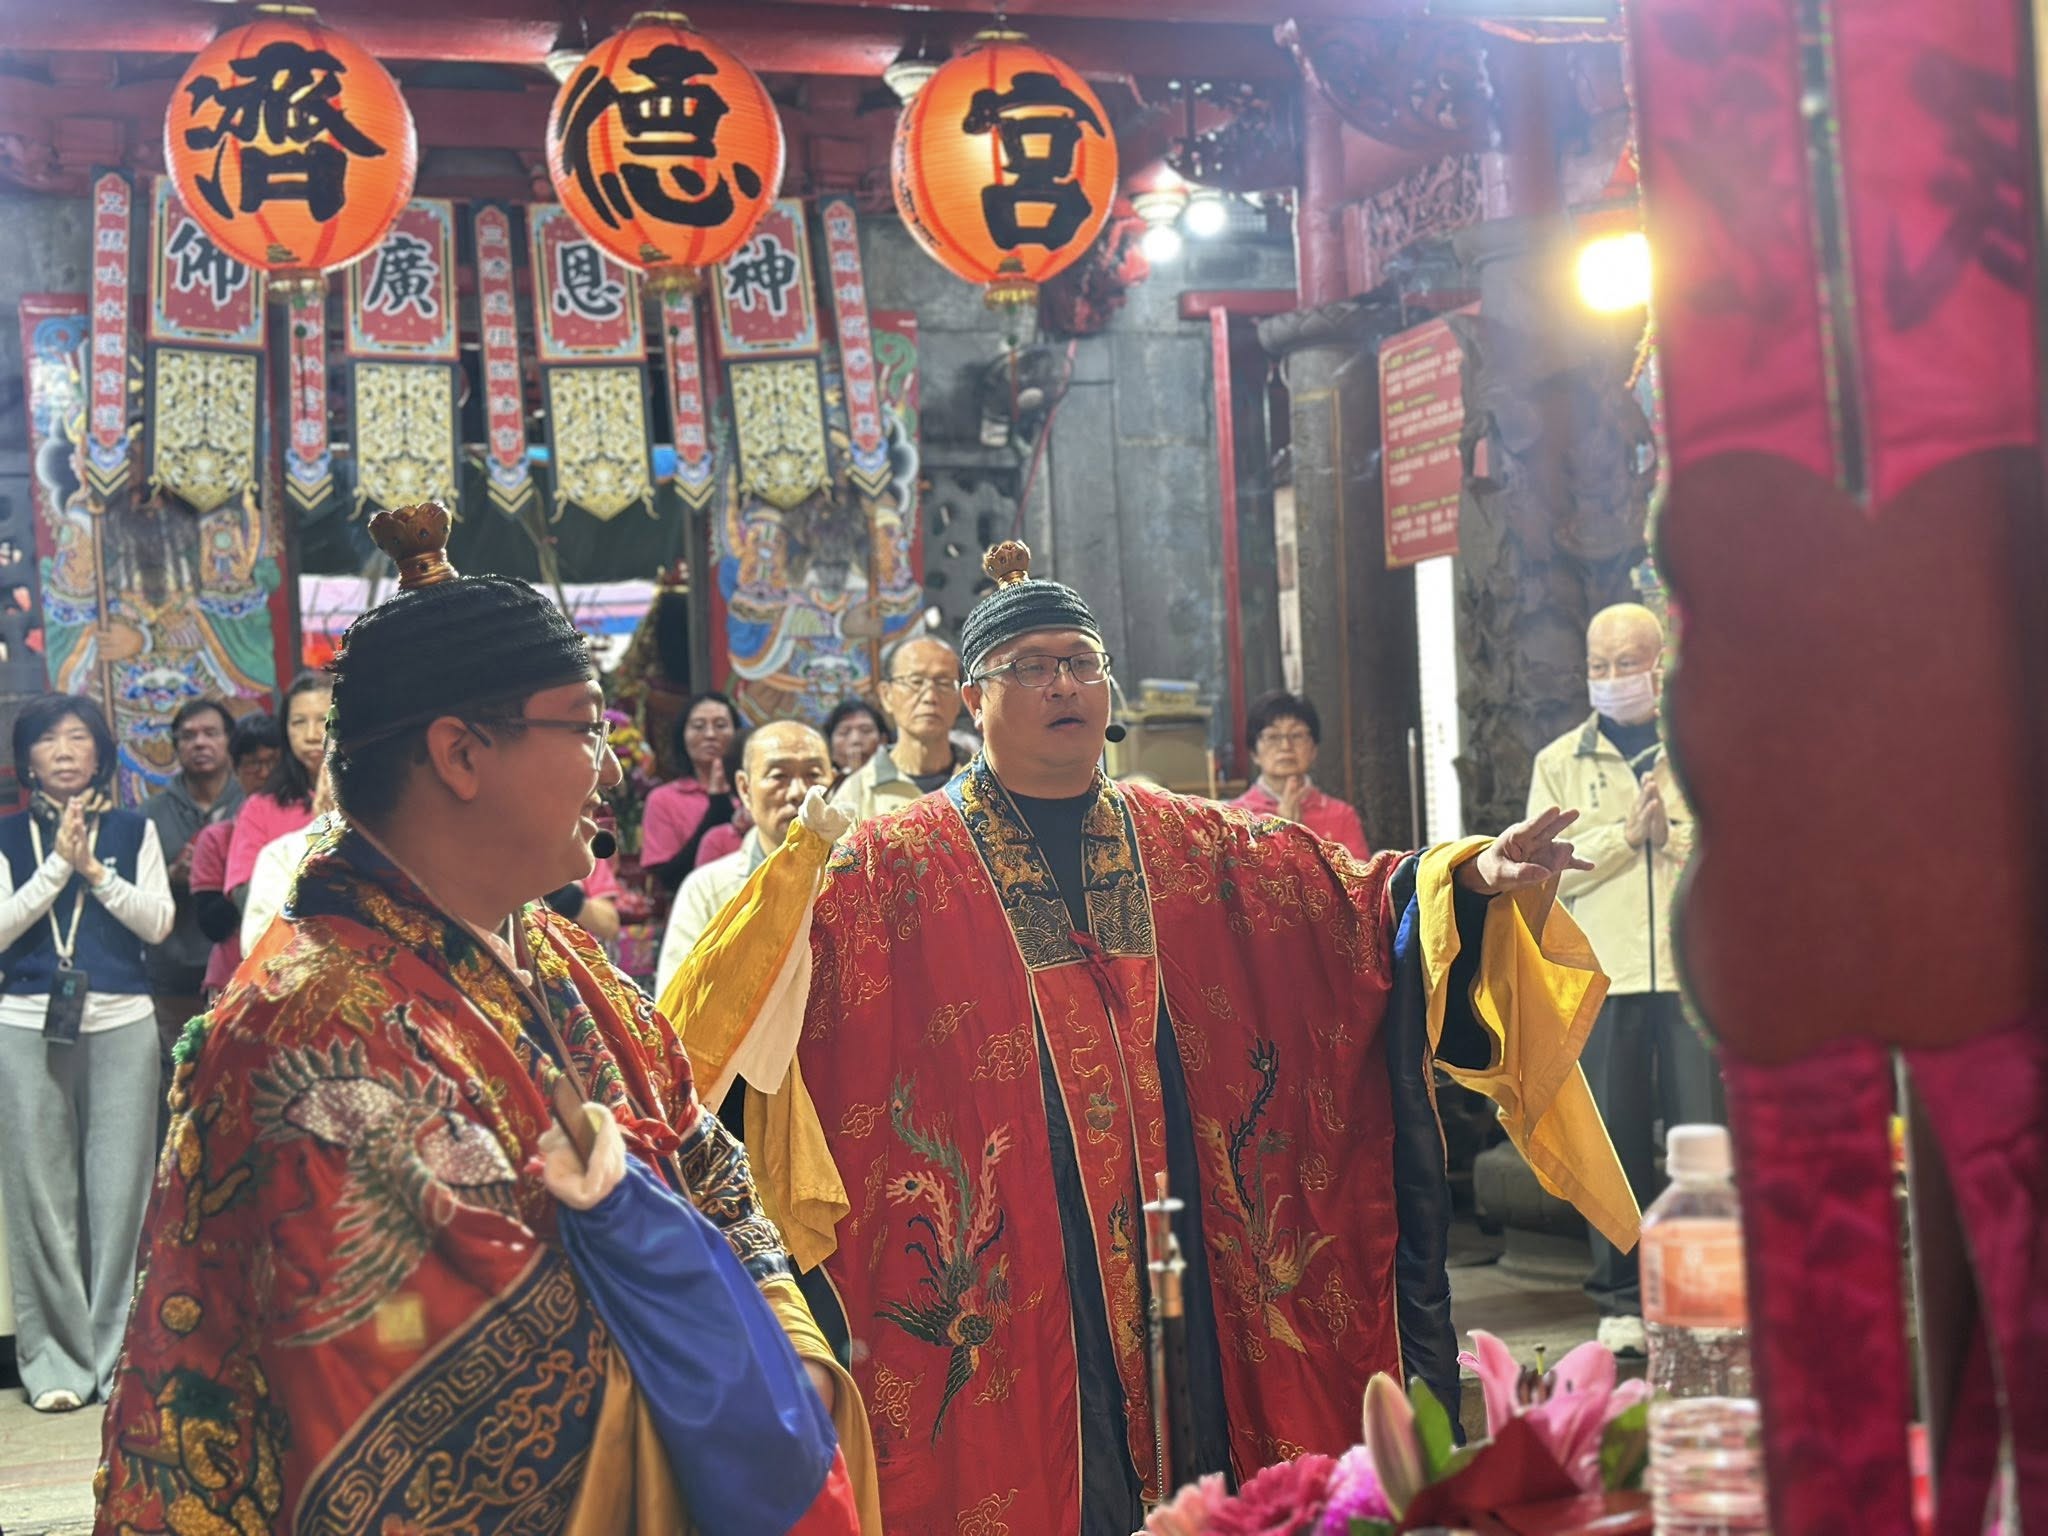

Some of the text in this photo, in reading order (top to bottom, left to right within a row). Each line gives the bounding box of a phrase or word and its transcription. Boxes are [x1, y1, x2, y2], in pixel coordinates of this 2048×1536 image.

[185, 41, 387, 222] 濟
[557, 43, 762, 230] 德
[963, 71, 1106, 251] 宮
[365, 234, 437, 316] 廣
[555, 242, 622, 317] 恩
[726, 237, 797, 312] 神
